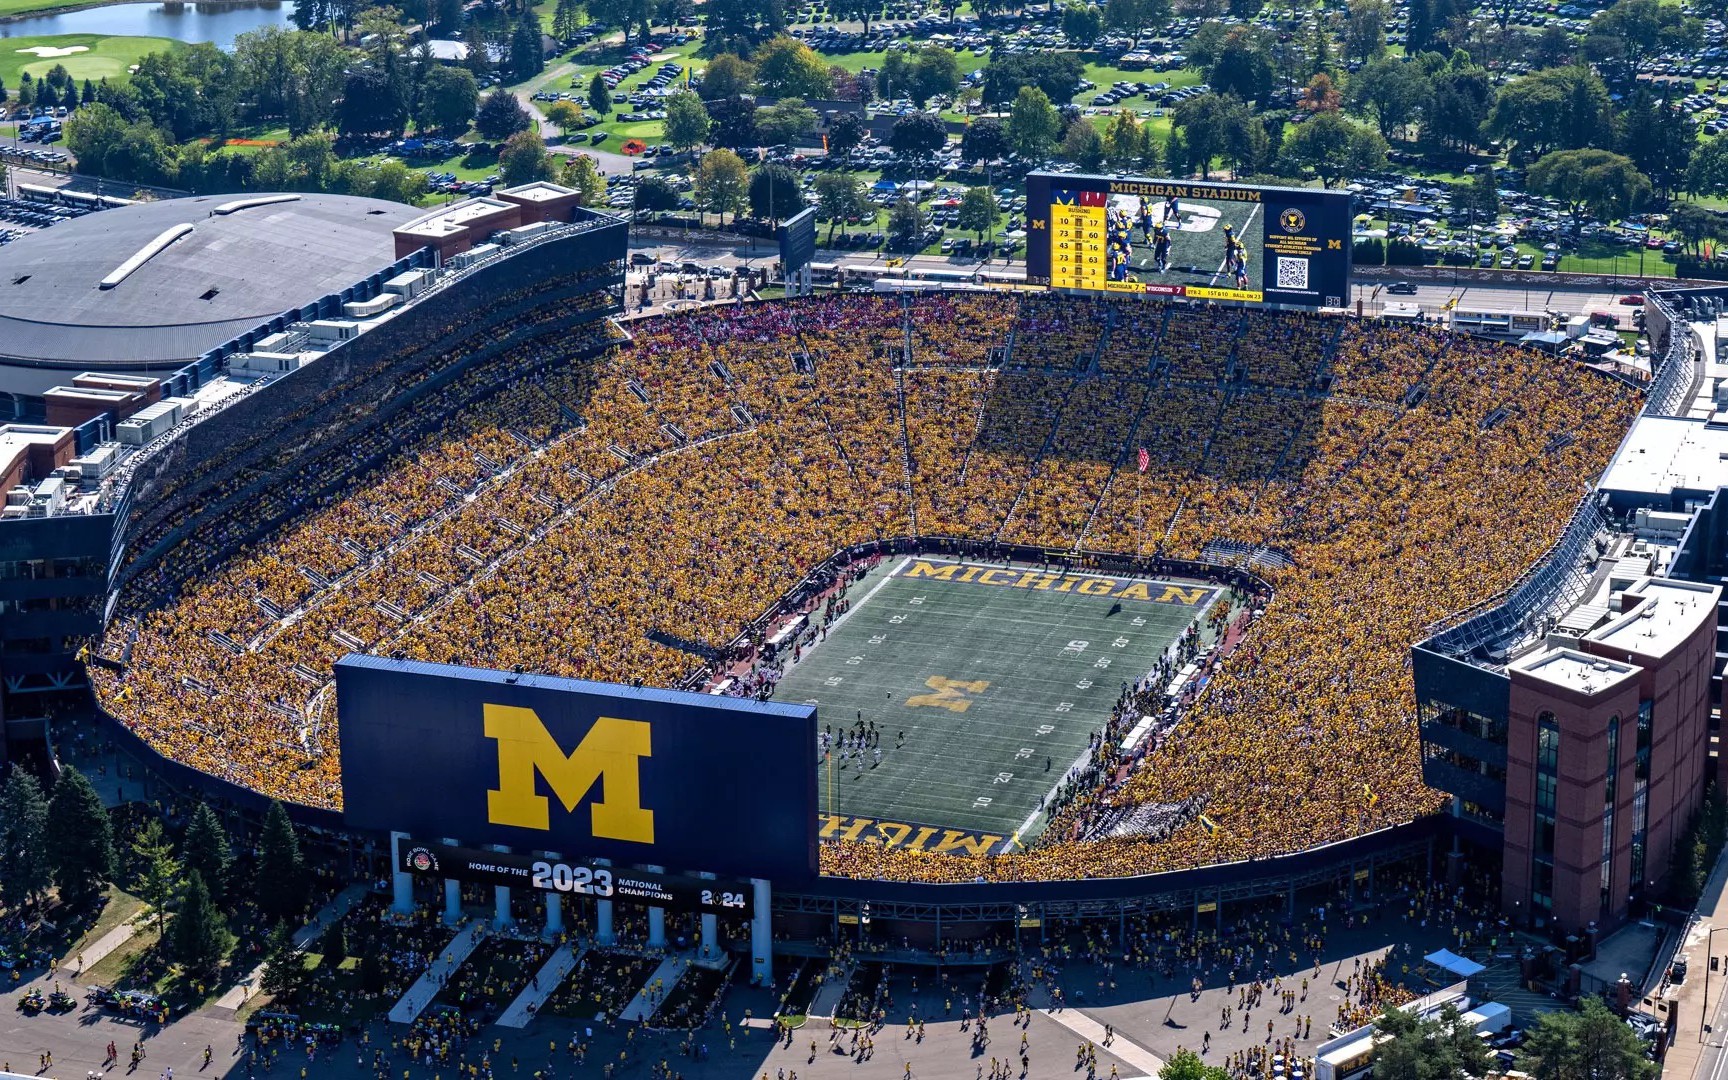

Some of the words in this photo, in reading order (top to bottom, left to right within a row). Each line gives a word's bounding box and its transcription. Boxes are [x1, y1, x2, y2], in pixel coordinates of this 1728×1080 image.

[1110, 182, 1188, 197] MICHIGAN
[1192, 187, 1261, 201] STADIUM
[1032, 219, 1045, 229] M
[1328, 239, 1341, 249] M
[1146, 285, 1173, 293] WISCONSIN
[902, 561, 1209, 605] MICHIGAN
[1111, 637, 1130, 648] 20
[1093, 658, 1112, 669] 30
[1055, 702, 1074, 712] 50
[1016, 748, 1035, 759] 30
[483, 703, 655, 844] M
[994, 772, 1014, 784] 20
[973, 796, 993, 807] 10
[819, 815, 1002, 858] MICH
[406, 850, 414, 867] ROSE
[412, 846, 430, 855] BOWL
[430, 853, 439, 871] GAME
[468, 862, 495, 873] HOME
[496, 865, 509, 874] OF
[511, 867, 529, 877] THE
[532, 861, 614, 897] 2023
[618, 878, 663, 891] NATIONAL
[618, 887, 673, 900] CHAMPIONS
